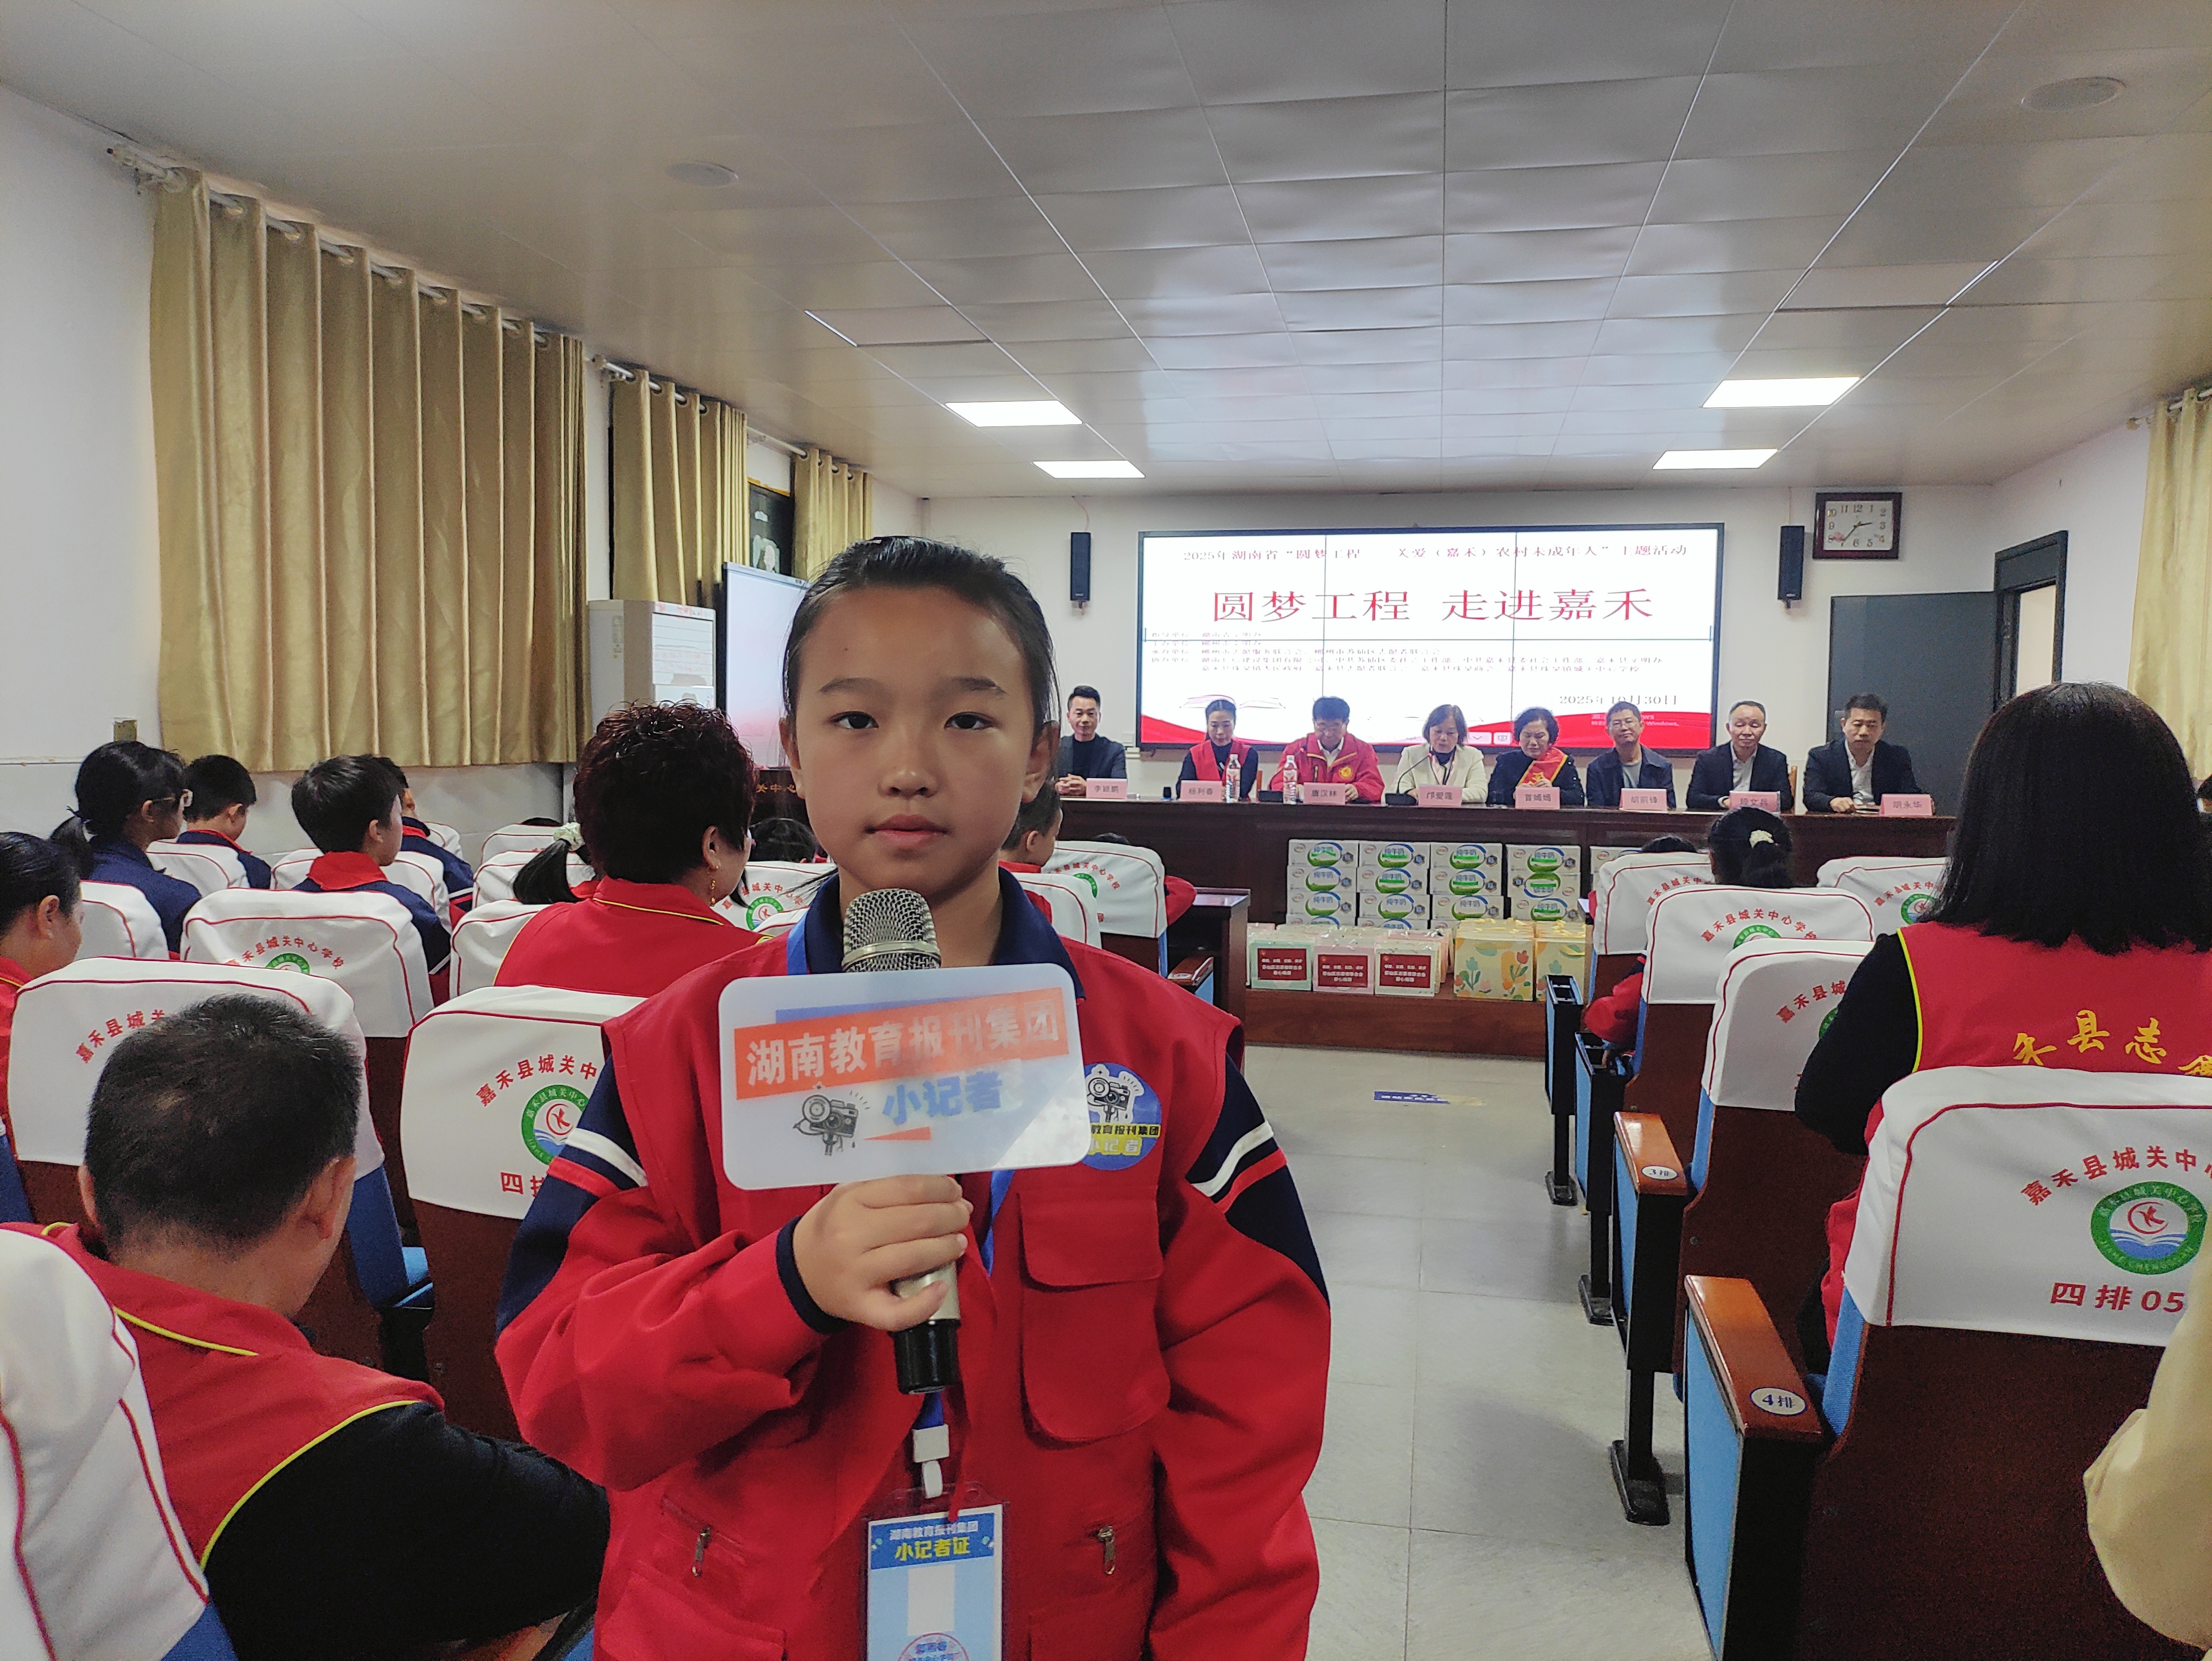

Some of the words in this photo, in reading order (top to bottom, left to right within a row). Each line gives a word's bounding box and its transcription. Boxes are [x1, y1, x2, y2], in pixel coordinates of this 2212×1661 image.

[1880, 508, 1887, 517] 2
[1214, 590, 1410, 623] 圆梦工程
[1442, 588, 1653, 621] 走进嘉禾
[1048, 862, 1120, 890] 禾县城关中心学校
[1647, 876, 1711, 905] 嘉禾县城关中
[226, 935, 344, 970] 禾县城关中心学校
[76, 1009, 178, 1064] 嘉禾县城关
[746, 998, 1060, 1087] 湖南教育报刊集团
[475, 1054, 598, 1107] 嘉禾县城关中
[882, 1069, 1003, 1126] 小记者
[894, 1536, 971, 1561] 小记者证
